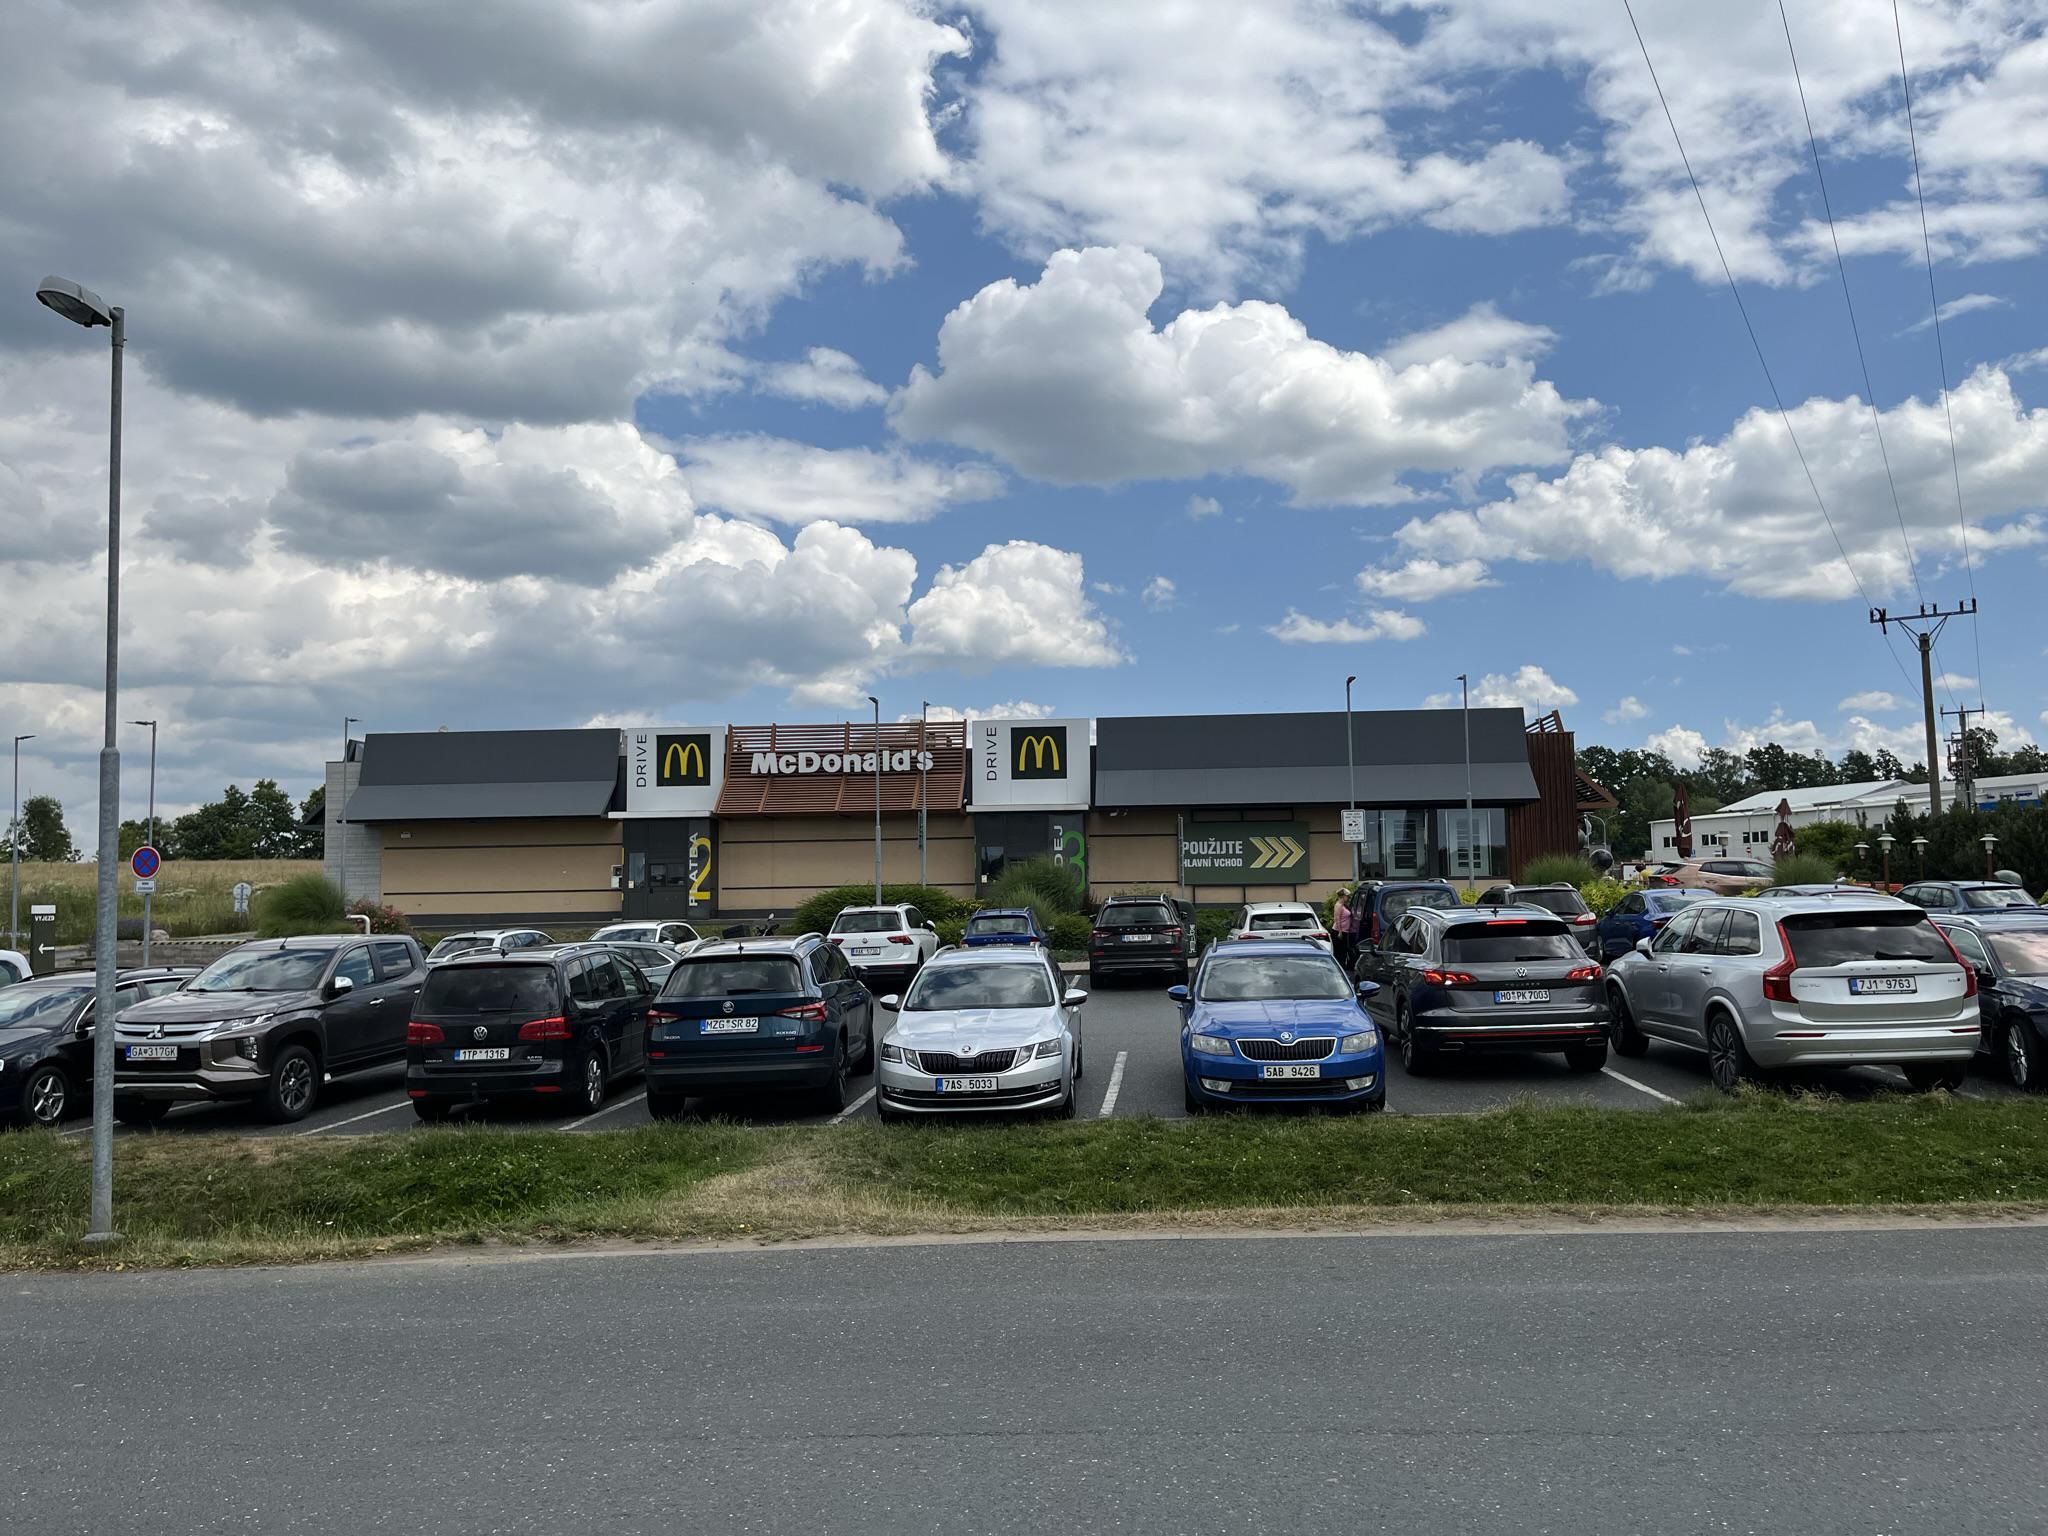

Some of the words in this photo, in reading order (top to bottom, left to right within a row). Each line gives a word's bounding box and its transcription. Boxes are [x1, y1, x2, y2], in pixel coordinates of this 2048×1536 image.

[986, 727, 997, 781] DRIVE
[636, 734, 647, 788] DRIVE
[750, 750, 934, 774] McDonald's
[1182, 837, 1243, 855] POUŽIJTE
[1214, 858, 1243, 868] VCHOD
[688, 832, 699, 907] PLATBA
[34, 914, 56, 922] VYJEZD
[1859, 979, 1879, 990] 7J1
[1886, 978, 1911, 989] 9763
[1517, 991, 1527, 1000] PK
[1529, 990, 1549, 1000] 7003
[706, 1021, 725, 1030] MZG
[731, 1019, 744, 1029] SR
[745, 1018, 758, 1028] 82
[462, 1050, 478, 1060] 1TP
[485, 1049, 505, 1059] 1316
[1265, 1067, 1284, 1077] 5AB
[1291, 1066, 1316, 1077] 9426
[944, 1080, 962, 1090] 7AS
[968, 1079, 993, 1090] 5033
